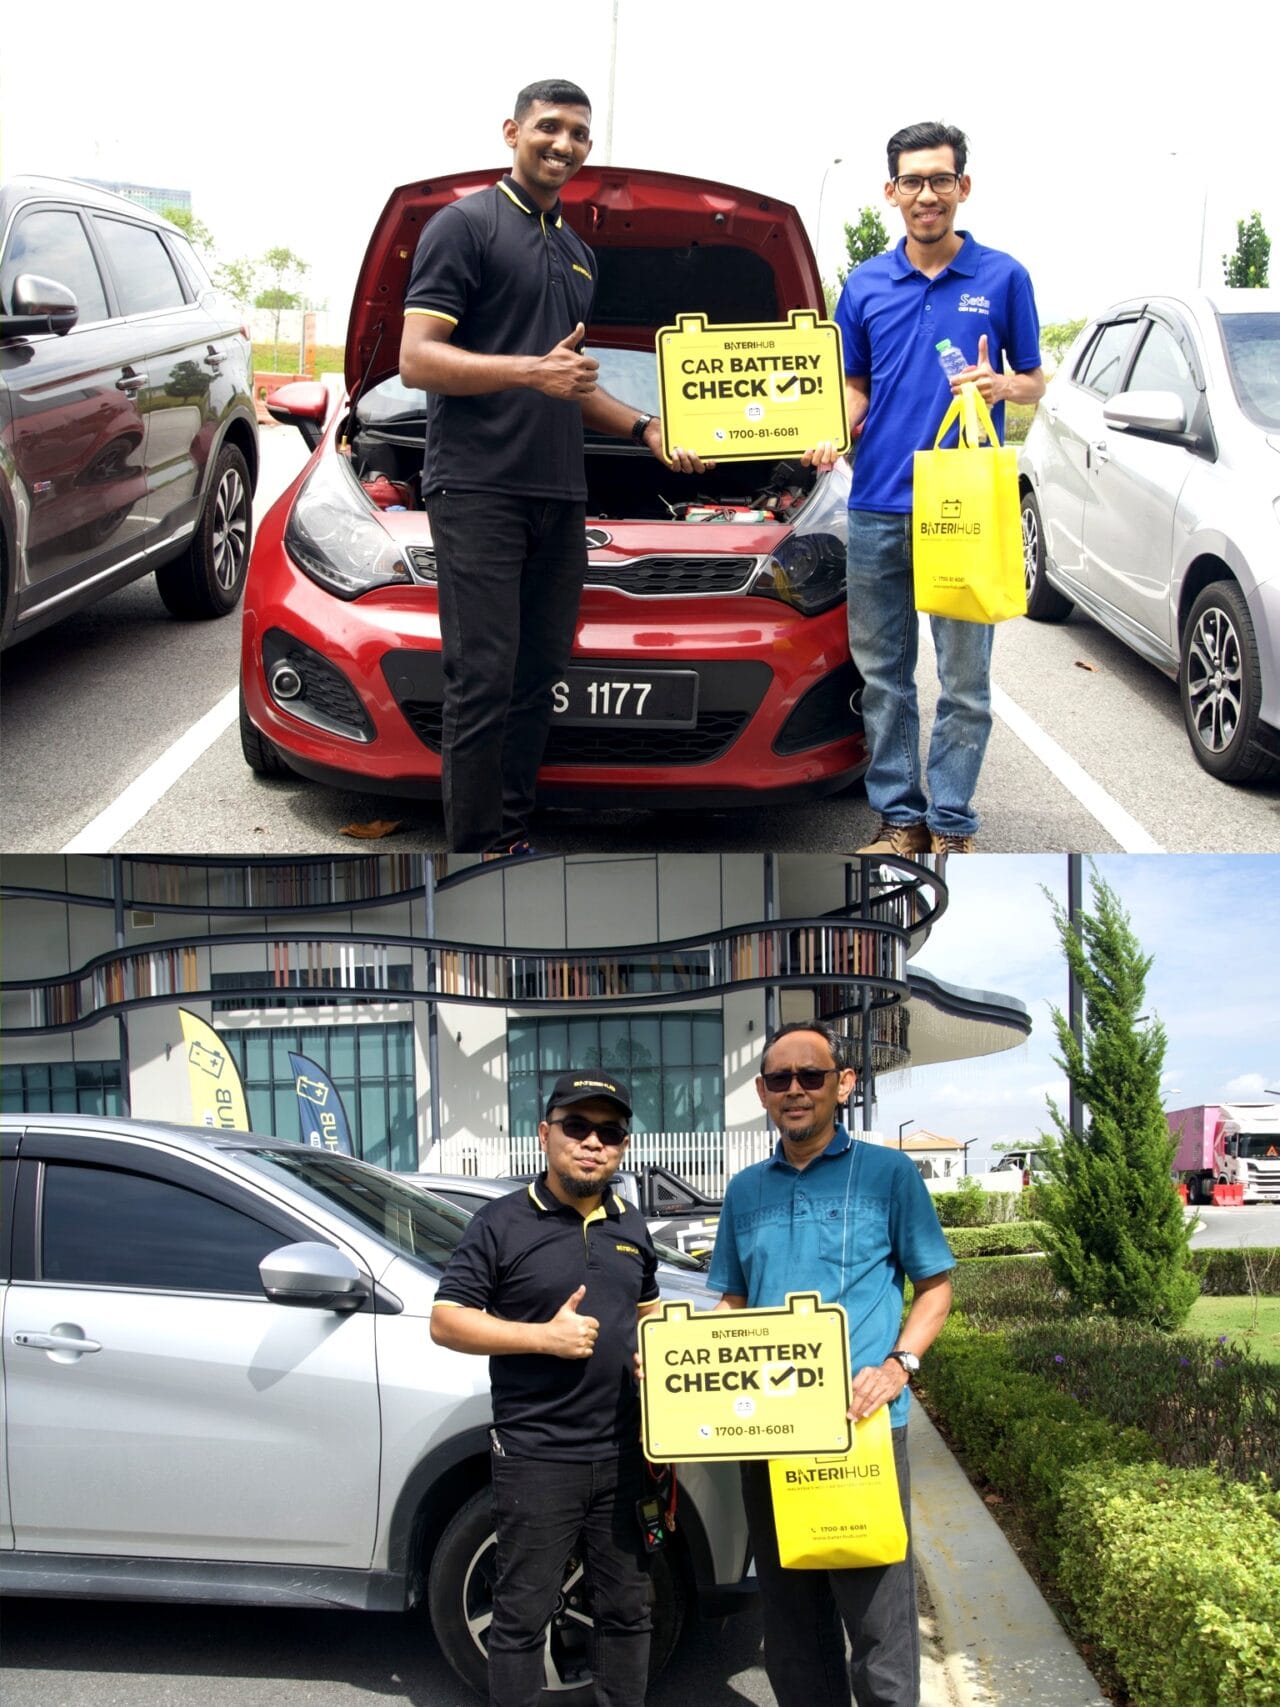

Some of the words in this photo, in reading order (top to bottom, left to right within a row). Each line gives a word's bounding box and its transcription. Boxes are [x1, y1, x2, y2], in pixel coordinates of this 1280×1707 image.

[959, 294, 990, 309] Setia
[724, 341, 775, 351] BATERIHUB
[681, 359, 724, 374] CAR
[730, 354, 821, 373] BATTERY
[682, 378, 768, 400] CHECK
[729, 427, 799, 440] 1700-81-6081
[920, 522, 981, 536] BATERIHUB
[587, 682, 652, 715] 1177
[711, 1328, 770, 1339] BATERIHUB
[664, 1348, 711, 1366] CAR
[718, 1342, 823, 1363] BATTERY
[665, 1369, 760, 1393] CHECK
[715, 1424, 794, 1436] 1700-81-6081
[785, 1464, 881, 1485] BATERIHUB
